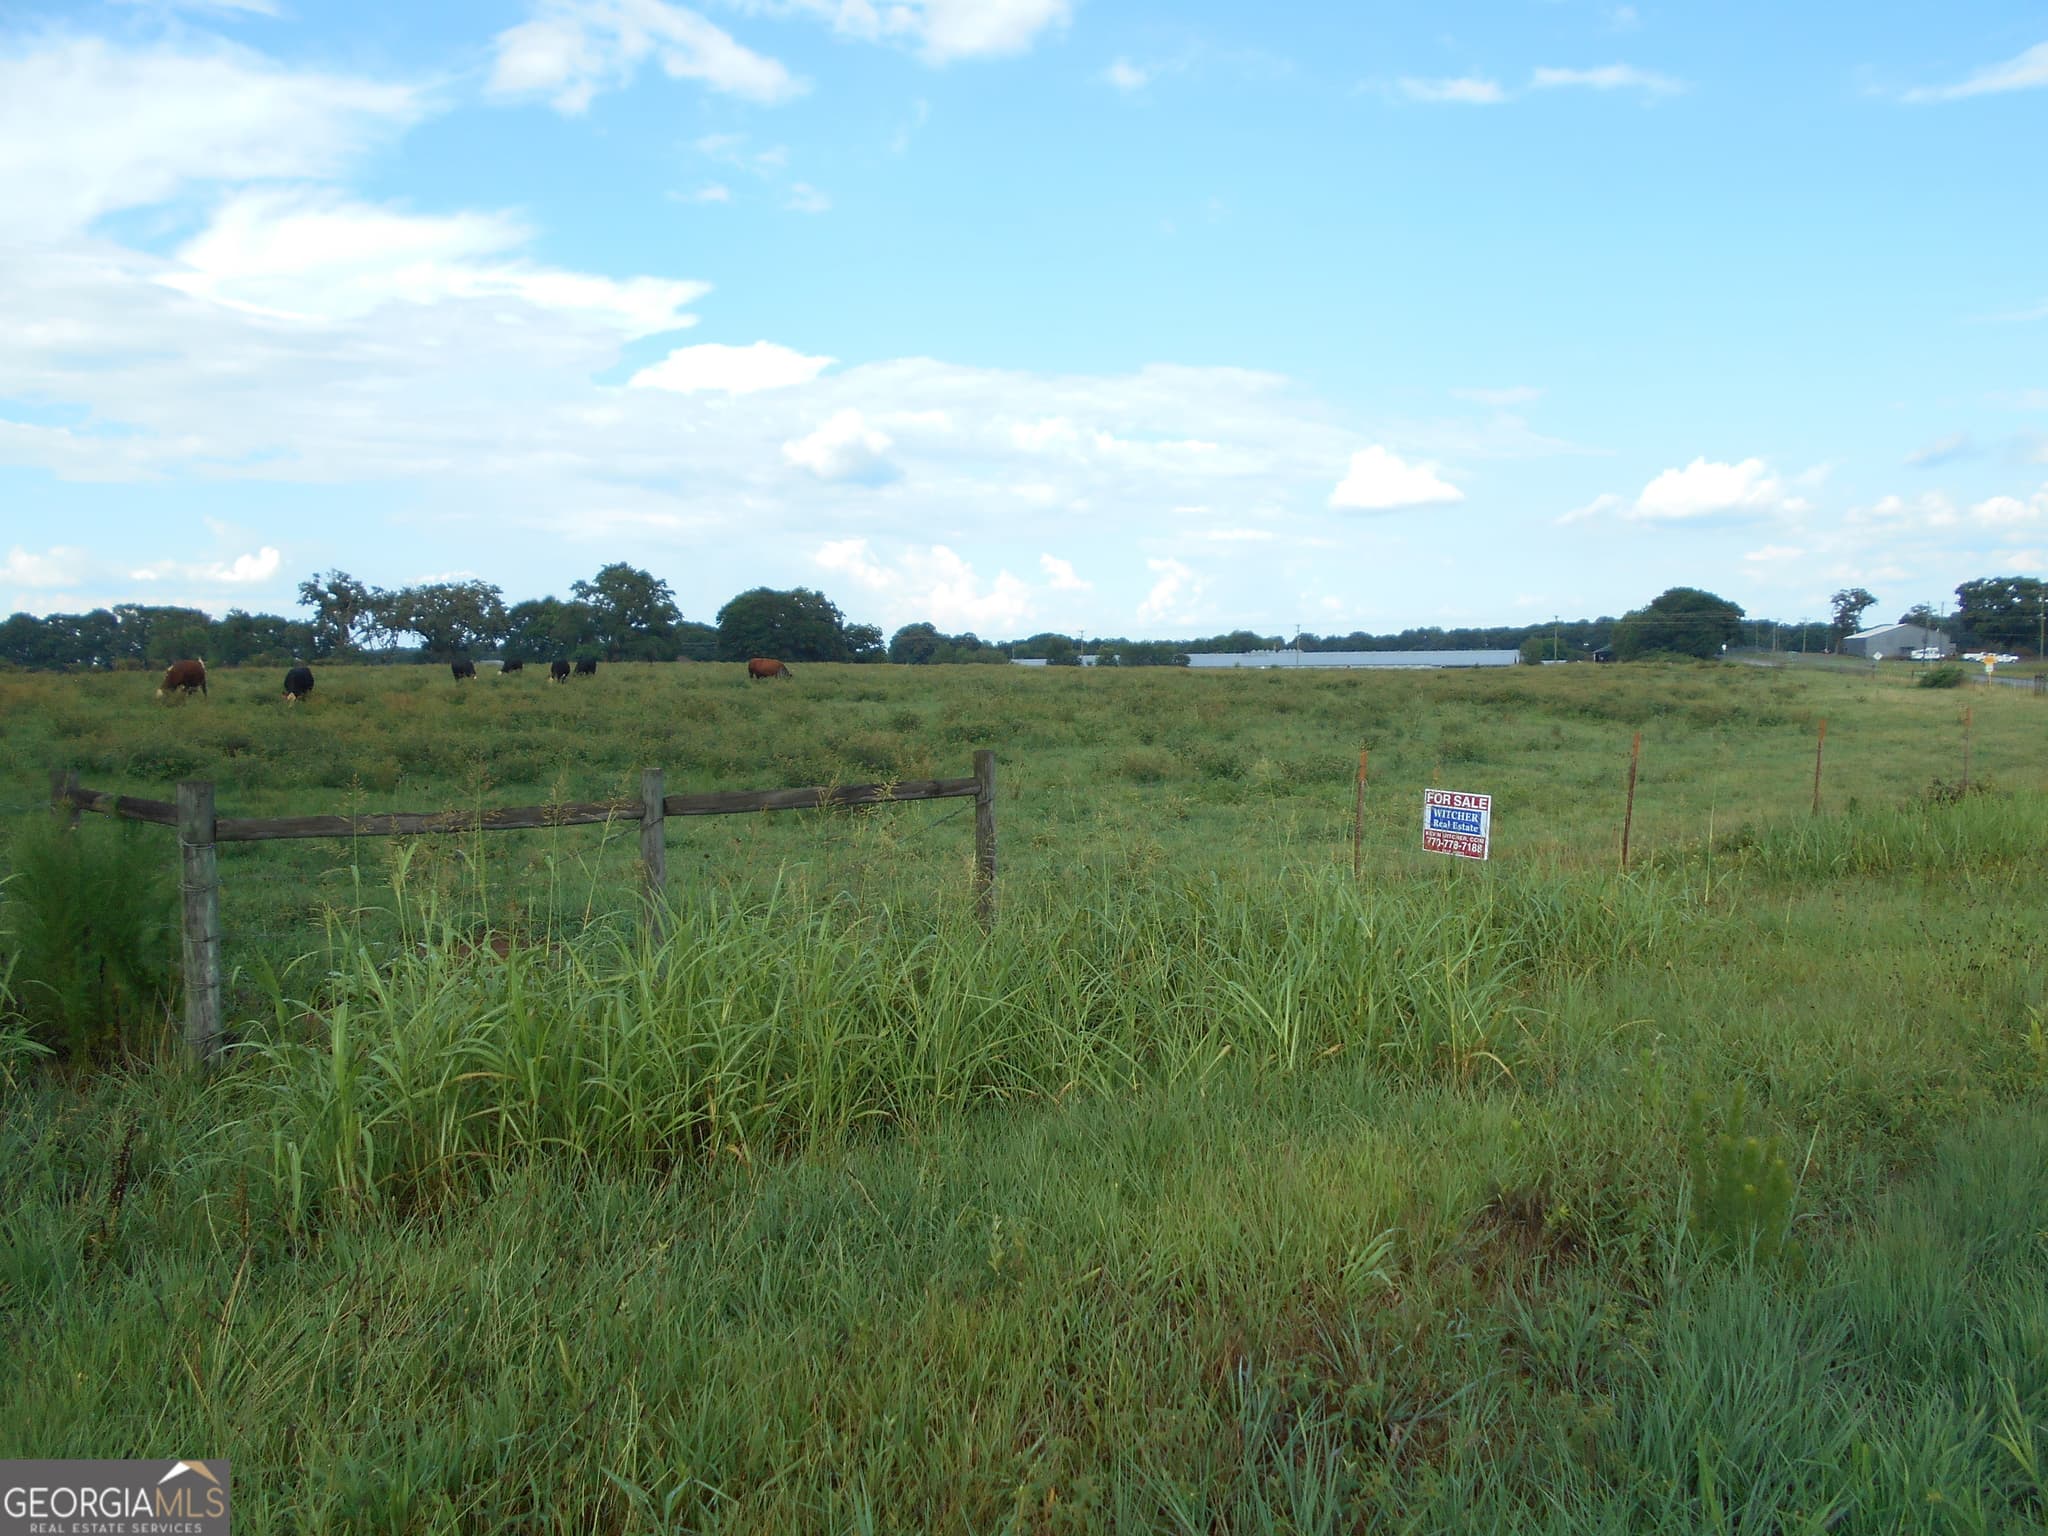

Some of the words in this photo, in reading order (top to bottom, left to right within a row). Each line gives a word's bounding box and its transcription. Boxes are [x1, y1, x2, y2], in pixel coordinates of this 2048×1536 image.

[1427, 791, 1451, 805] FOR
[1453, 795, 1487, 809] SALE
[1433, 808, 1479, 822] WITCHER
[1433, 819, 1451, 829] Real
[1453, 821, 1479, 833] Estate
